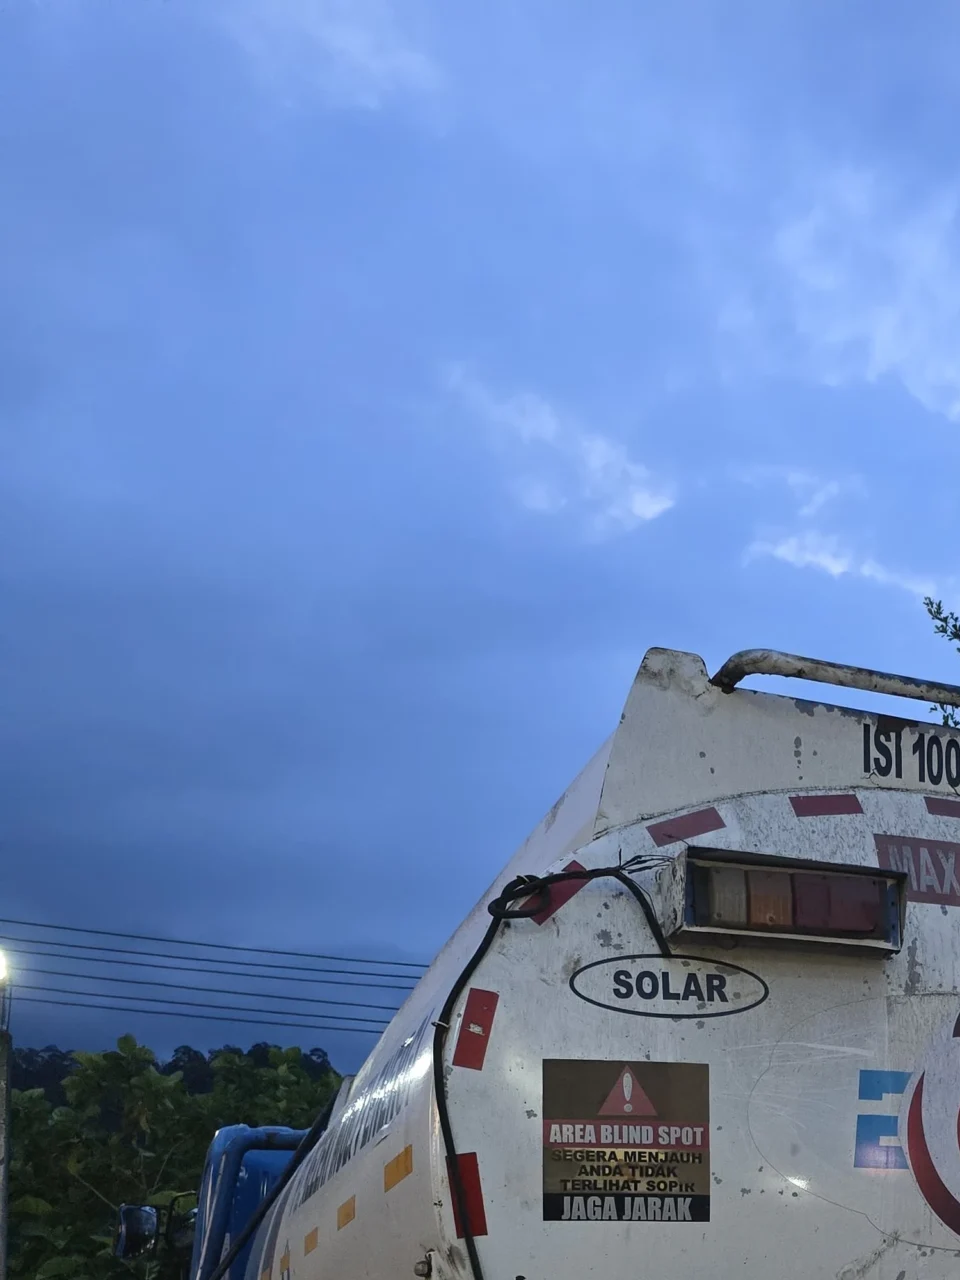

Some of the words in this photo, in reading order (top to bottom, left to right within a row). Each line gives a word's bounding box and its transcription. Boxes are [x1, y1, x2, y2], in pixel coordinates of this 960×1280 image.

[863, 723, 902, 778] ISI
[612, 969, 729, 1003] SOLAR
[549, 1124, 597, 1144] AREA
[600, 1125, 654, 1145] BLIND
[658, 1126, 704, 1146] SPOT
[551, 1150, 618, 1163] SEGERA
[623, 1151, 703, 1165] MENJAUH
[578, 1165, 624, 1177] ANDA
[629, 1166, 678, 1178] TIDAK
[560, 1179, 641, 1192] TERLIHAT
[561, 1196, 618, 1221] JAGA
[622, 1197, 693, 1222] JARAK
